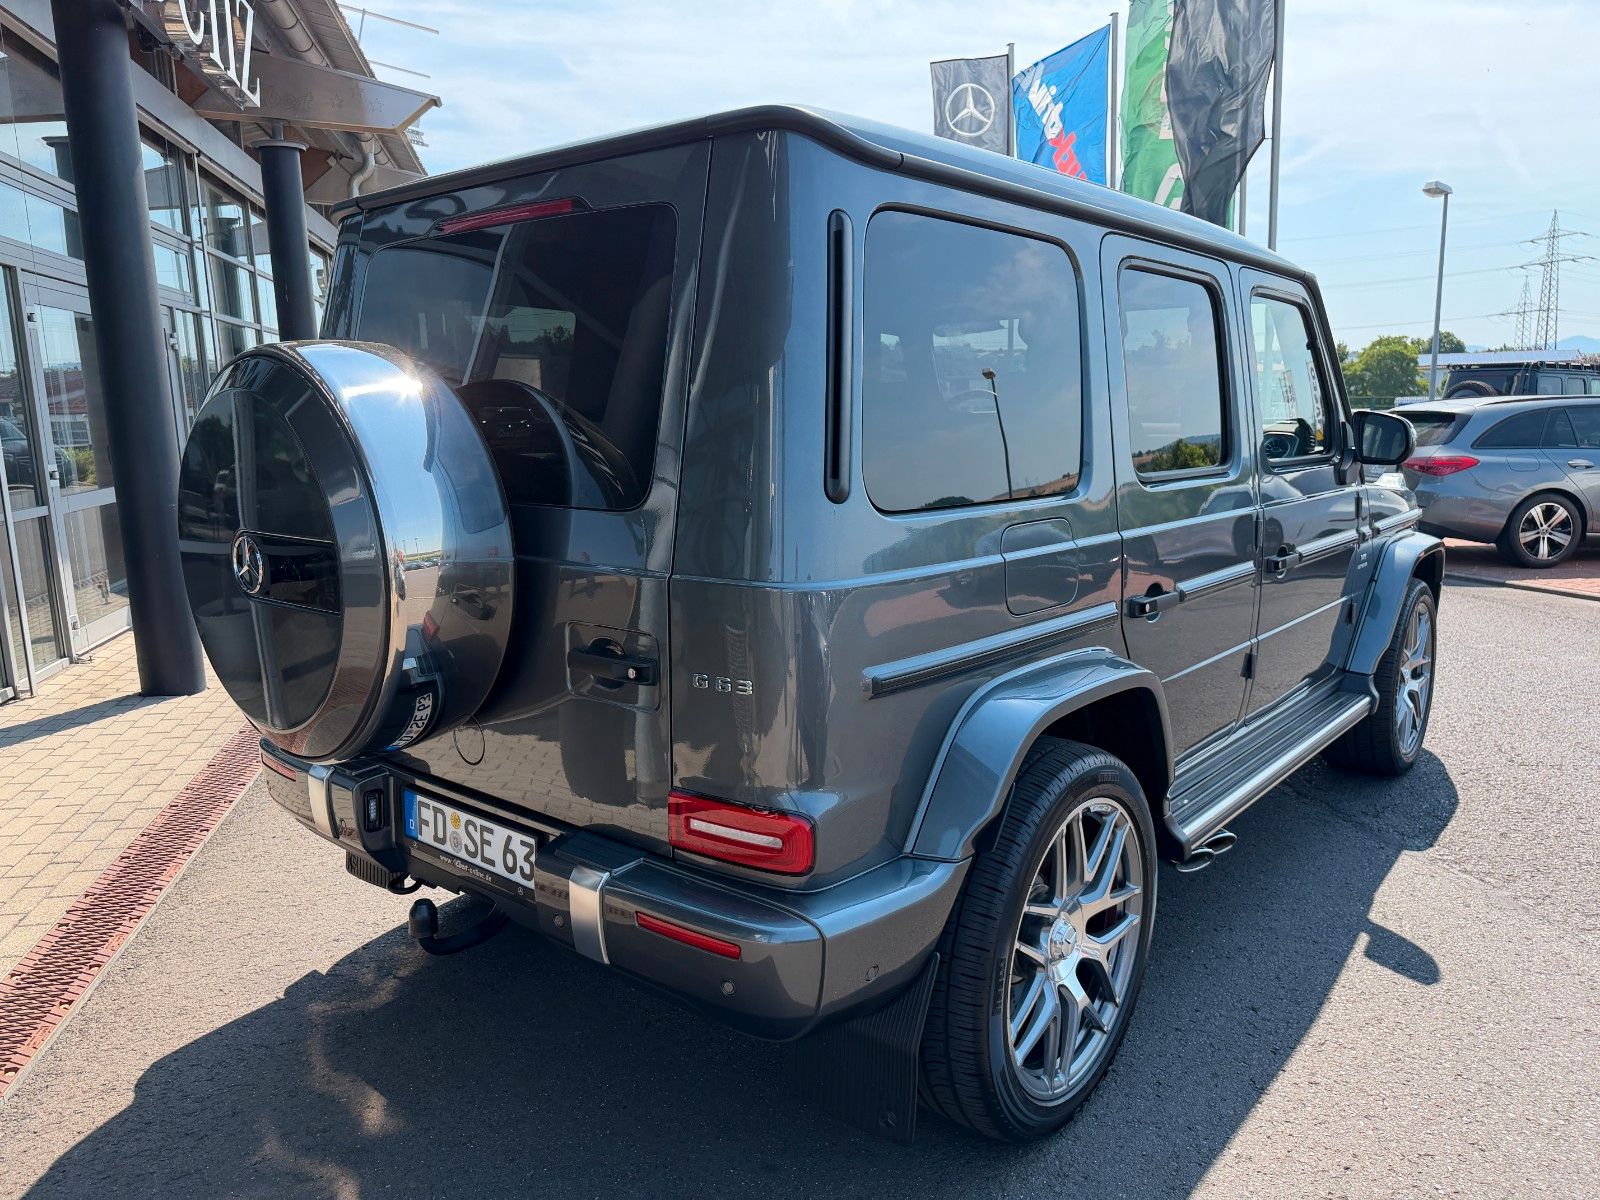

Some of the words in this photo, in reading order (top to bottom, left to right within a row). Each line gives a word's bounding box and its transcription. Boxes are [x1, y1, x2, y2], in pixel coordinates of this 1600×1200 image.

[409, 818, 415, 830] D
[417, 800, 447, 846] FD
[463, 819, 496, 868] SE
[502, 834, 535, 882] 63
